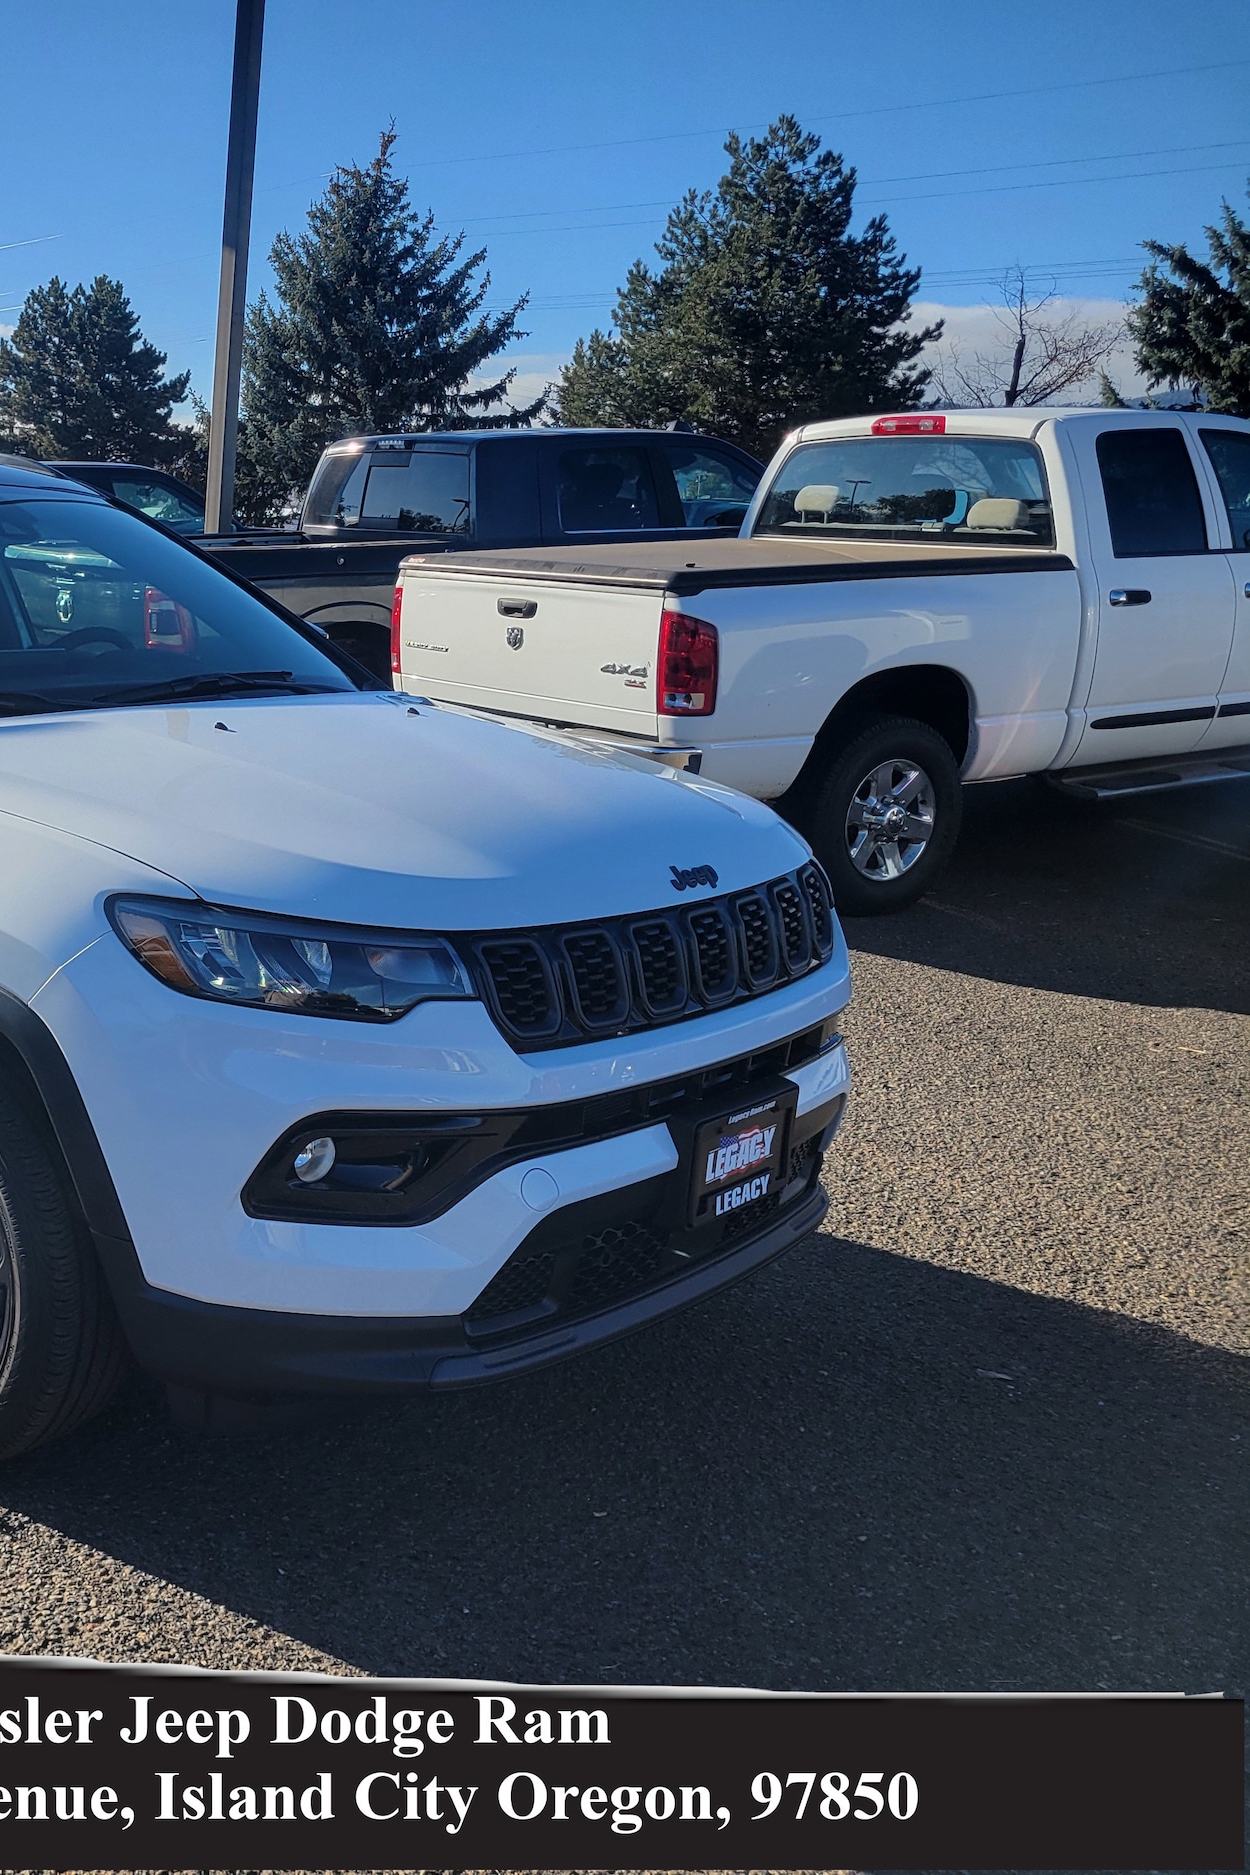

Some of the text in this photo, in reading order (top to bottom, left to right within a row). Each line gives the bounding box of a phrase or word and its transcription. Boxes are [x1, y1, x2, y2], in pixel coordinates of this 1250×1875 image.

[669, 865, 719, 891] Jeep
[705, 1126, 777, 1182] LEGACY
[715, 1174, 771, 1217] LEGACY
